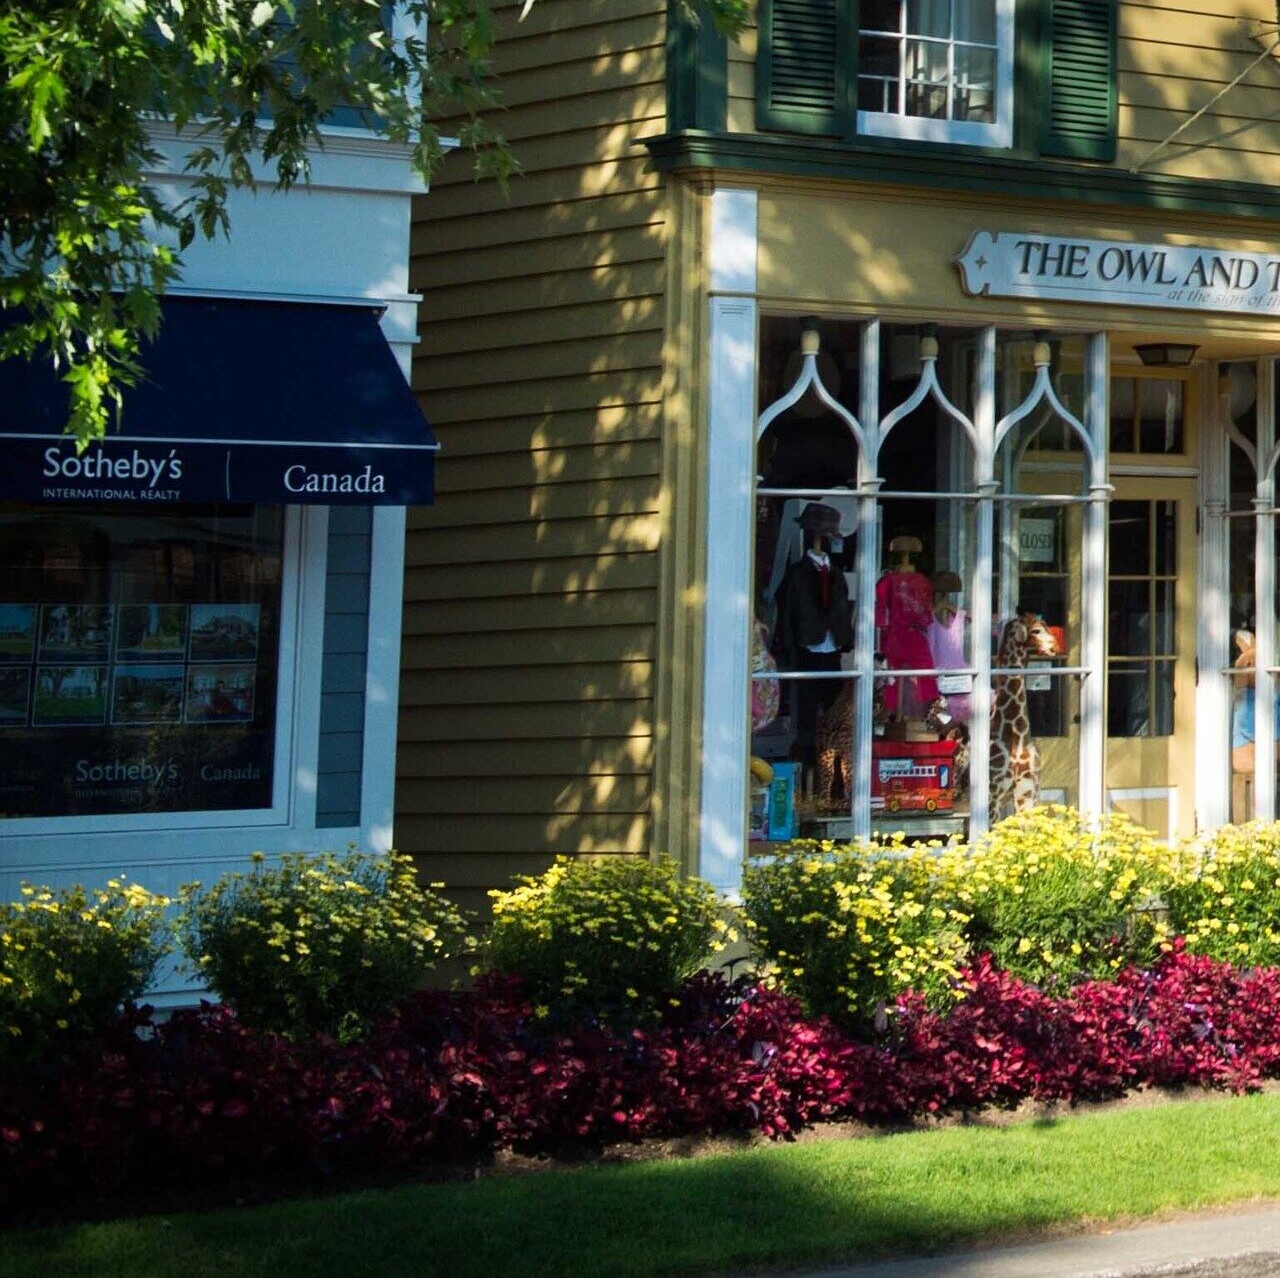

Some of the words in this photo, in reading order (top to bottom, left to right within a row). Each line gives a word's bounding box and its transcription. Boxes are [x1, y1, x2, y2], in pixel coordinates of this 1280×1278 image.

[1014, 240, 1091, 280] THE
[1096, 246, 1177, 286] OWL
[1182, 253, 1260, 291] AND
[1166, 290, 1184, 301] at
[1186, 289, 1208, 303] the
[1214, 293, 1244, 307] sign
[42, 446, 183, 488] Sotheby's
[284, 465, 386, 494] Canada
[43, 487, 137, 500] INTERNATIONAL
[140, 488, 181, 501] REALTY
[75, 757, 178, 788] Sotheby's
[200, 762, 262, 782] Canada
